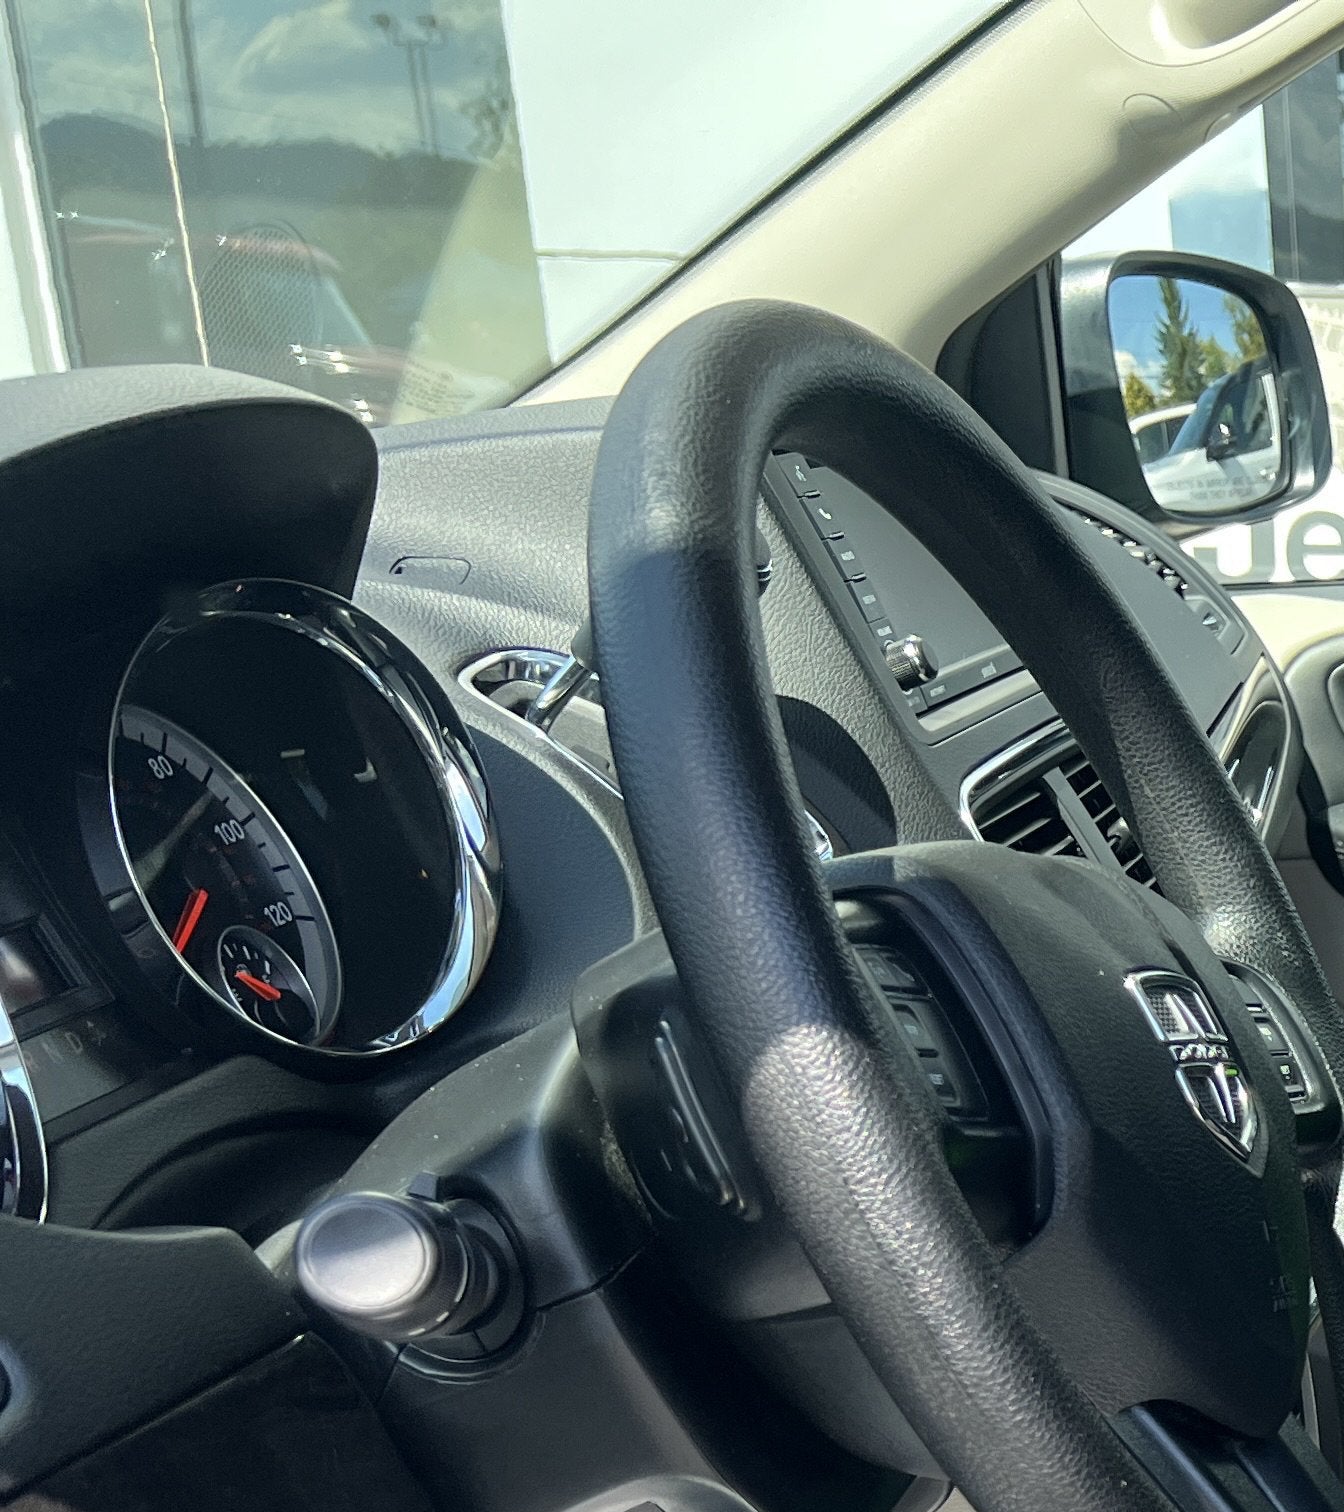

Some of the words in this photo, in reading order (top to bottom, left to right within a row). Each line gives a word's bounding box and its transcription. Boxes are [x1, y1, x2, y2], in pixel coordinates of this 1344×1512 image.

[148, 755, 173, 780] 80
[214, 819, 245, 846] 100
[264, 901, 293, 927] 120
